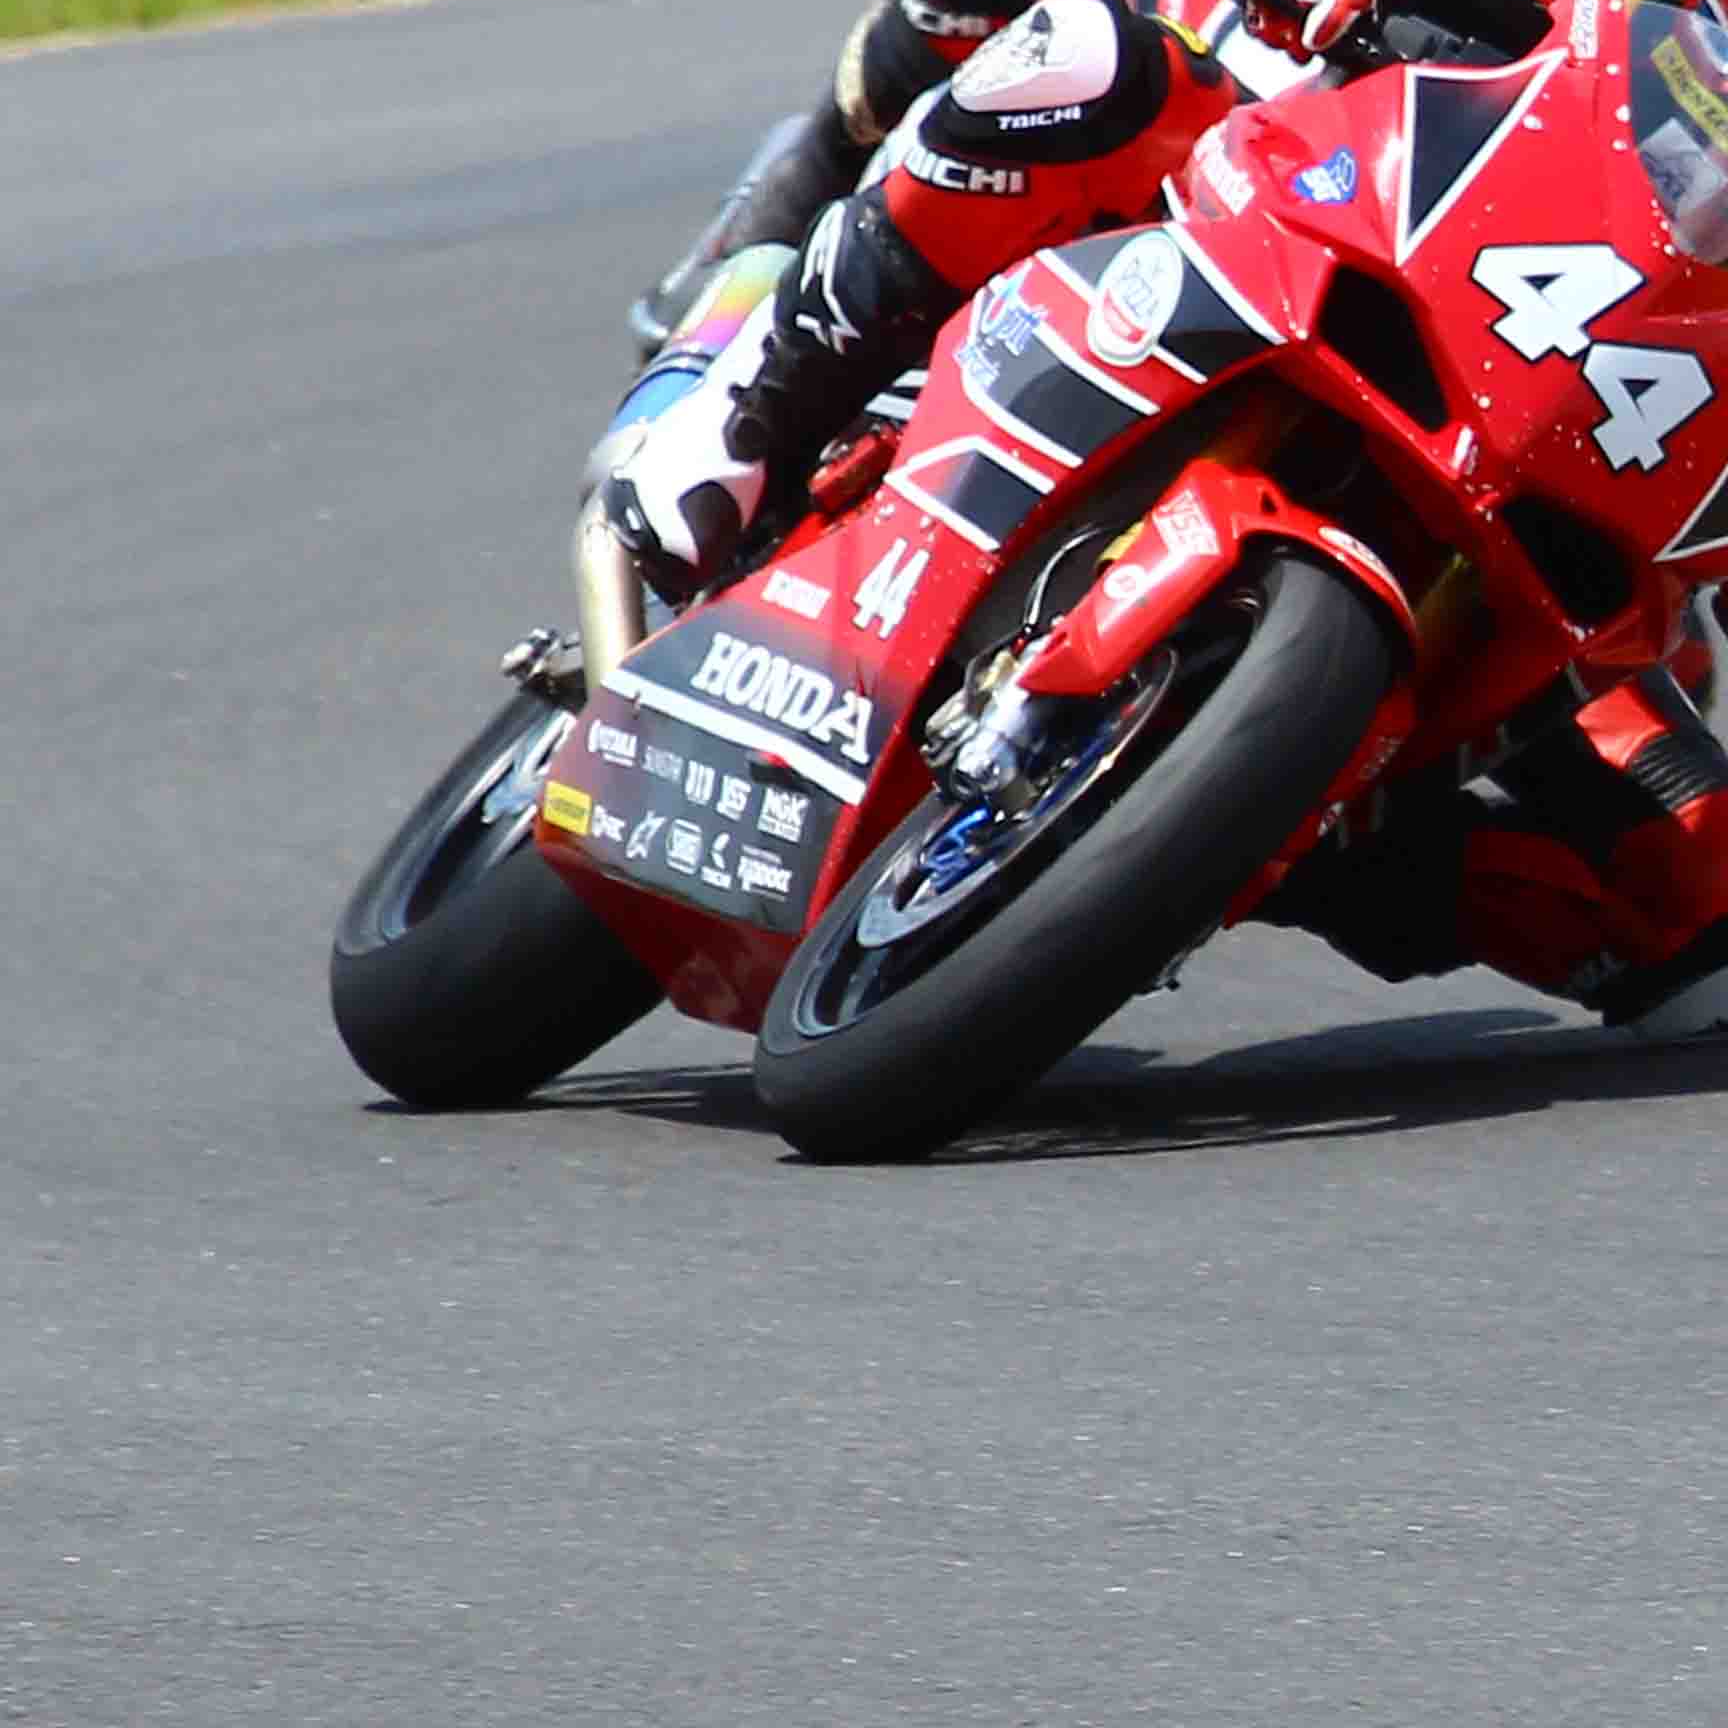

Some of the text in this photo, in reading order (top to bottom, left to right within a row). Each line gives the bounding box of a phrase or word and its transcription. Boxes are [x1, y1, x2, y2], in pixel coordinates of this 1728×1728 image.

[997, 105, 1082, 131] TAICHI
[1472, 242, 1714, 472] 44
[852, 537, 934, 640] 44
[690, 631, 874, 765] HONDA
